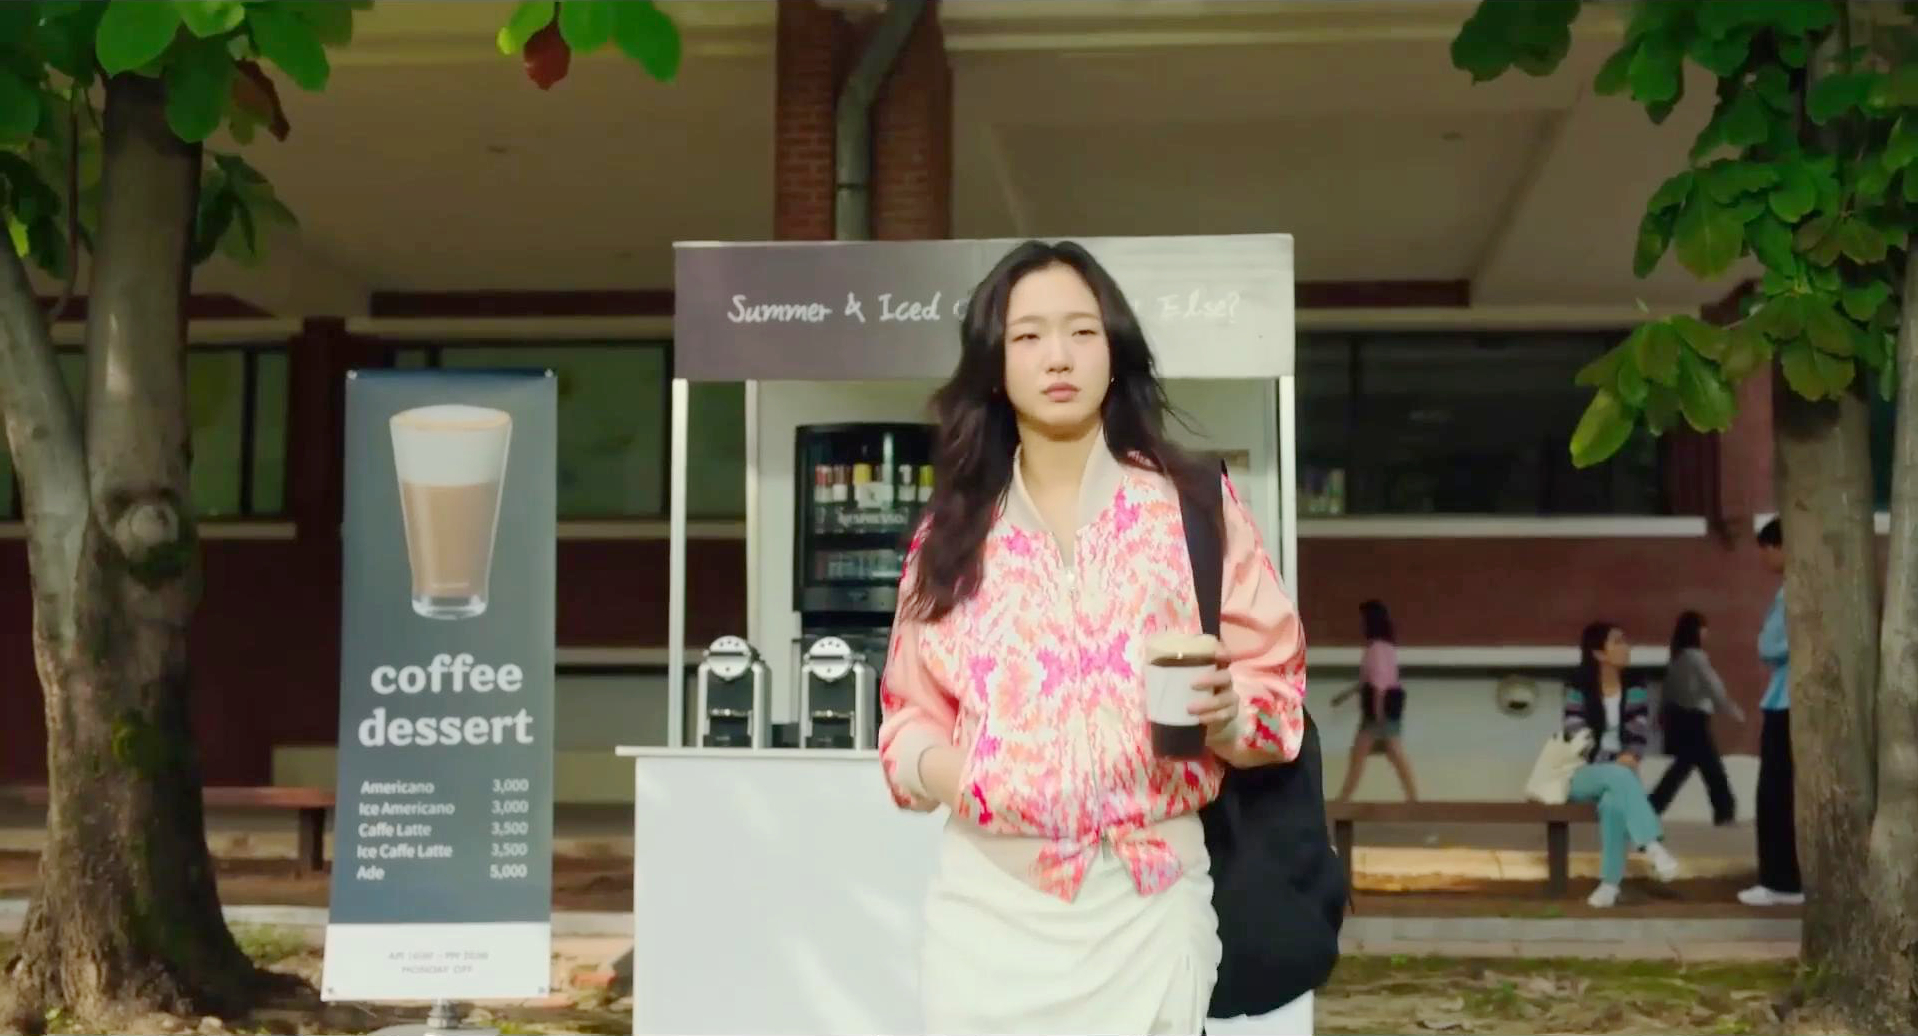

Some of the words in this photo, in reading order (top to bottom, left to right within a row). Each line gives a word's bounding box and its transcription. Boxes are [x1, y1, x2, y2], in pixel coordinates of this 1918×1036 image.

[727, 294, 833, 323] Summer
[844, 291, 866, 323] &
[878, 291, 942, 322] Iced
[1156, 288, 1240, 324] Else?
[371, 653, 523, 695] coffee
[358, 707, 534, 747] dessert
[360, 781, 435, 795] Americano
[492, 778, 529, 794] 3,000
[358, 802, 380, 816] Ice
[381, 801, 455, 816] Americano
[491, 800, 529, 815] 3,000
[358, 821, 394, 838] Caffe
[396, 823, 432, 837] Latte
[491, 821, 528, 836] 3,500
[357, 844, 377, 859] Ice
[379, 843, 415, 859] Caffe
[417, 844, 453, 858] Latte
[491, 843, 528, 858] 3,500
[356, 865, 385, 880] Ade
[490, 864, 527, 880] 5,000
